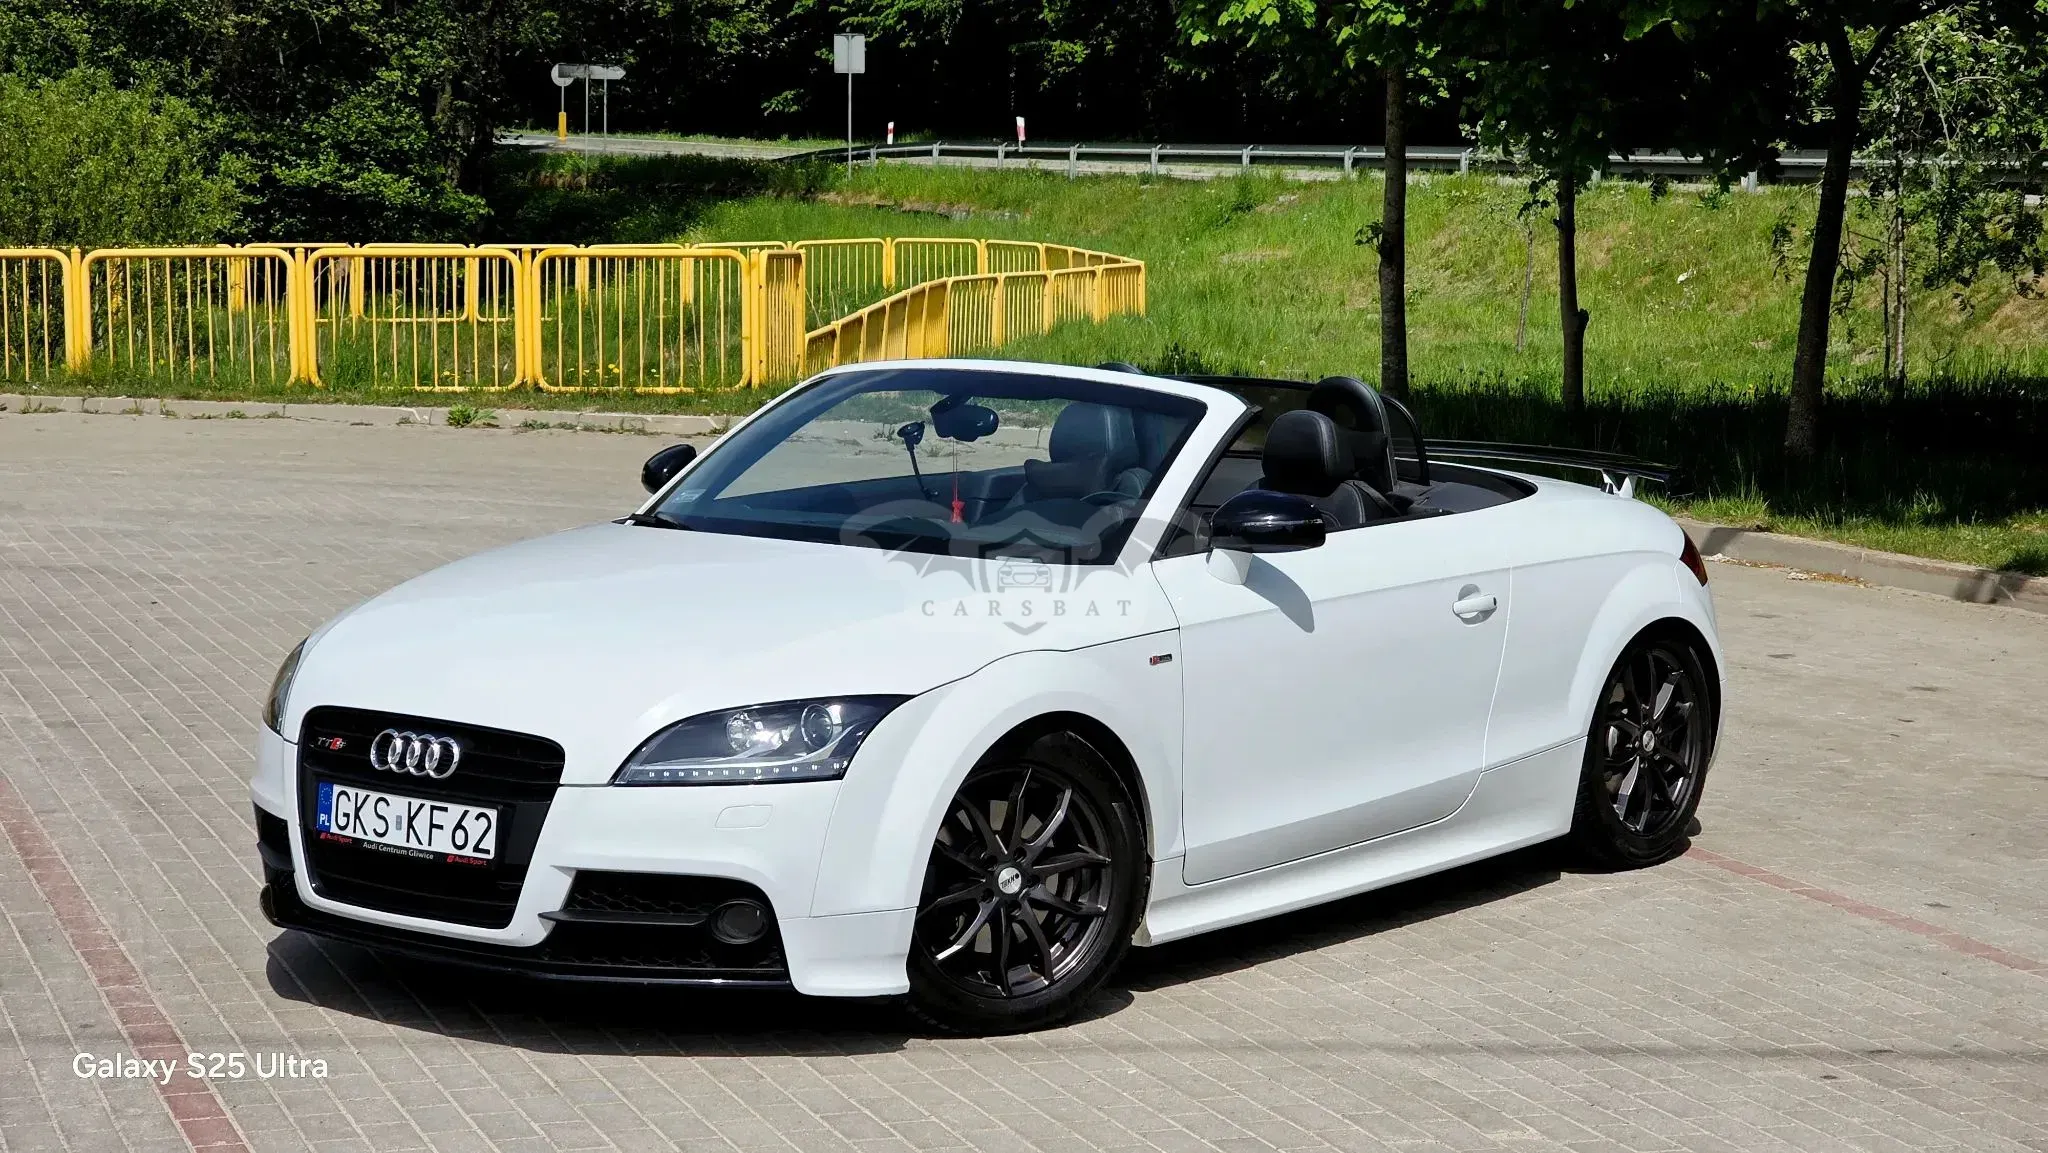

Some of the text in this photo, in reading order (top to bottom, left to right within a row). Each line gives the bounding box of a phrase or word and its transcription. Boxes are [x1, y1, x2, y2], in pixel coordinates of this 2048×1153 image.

[319, 813, 330, 826] PL
[334, 790, 493, 855] GKS KF62
[363, 841, 434, 860] Audi Centrum Gliwice
[454, 856, 487, 866] Audi Sport
